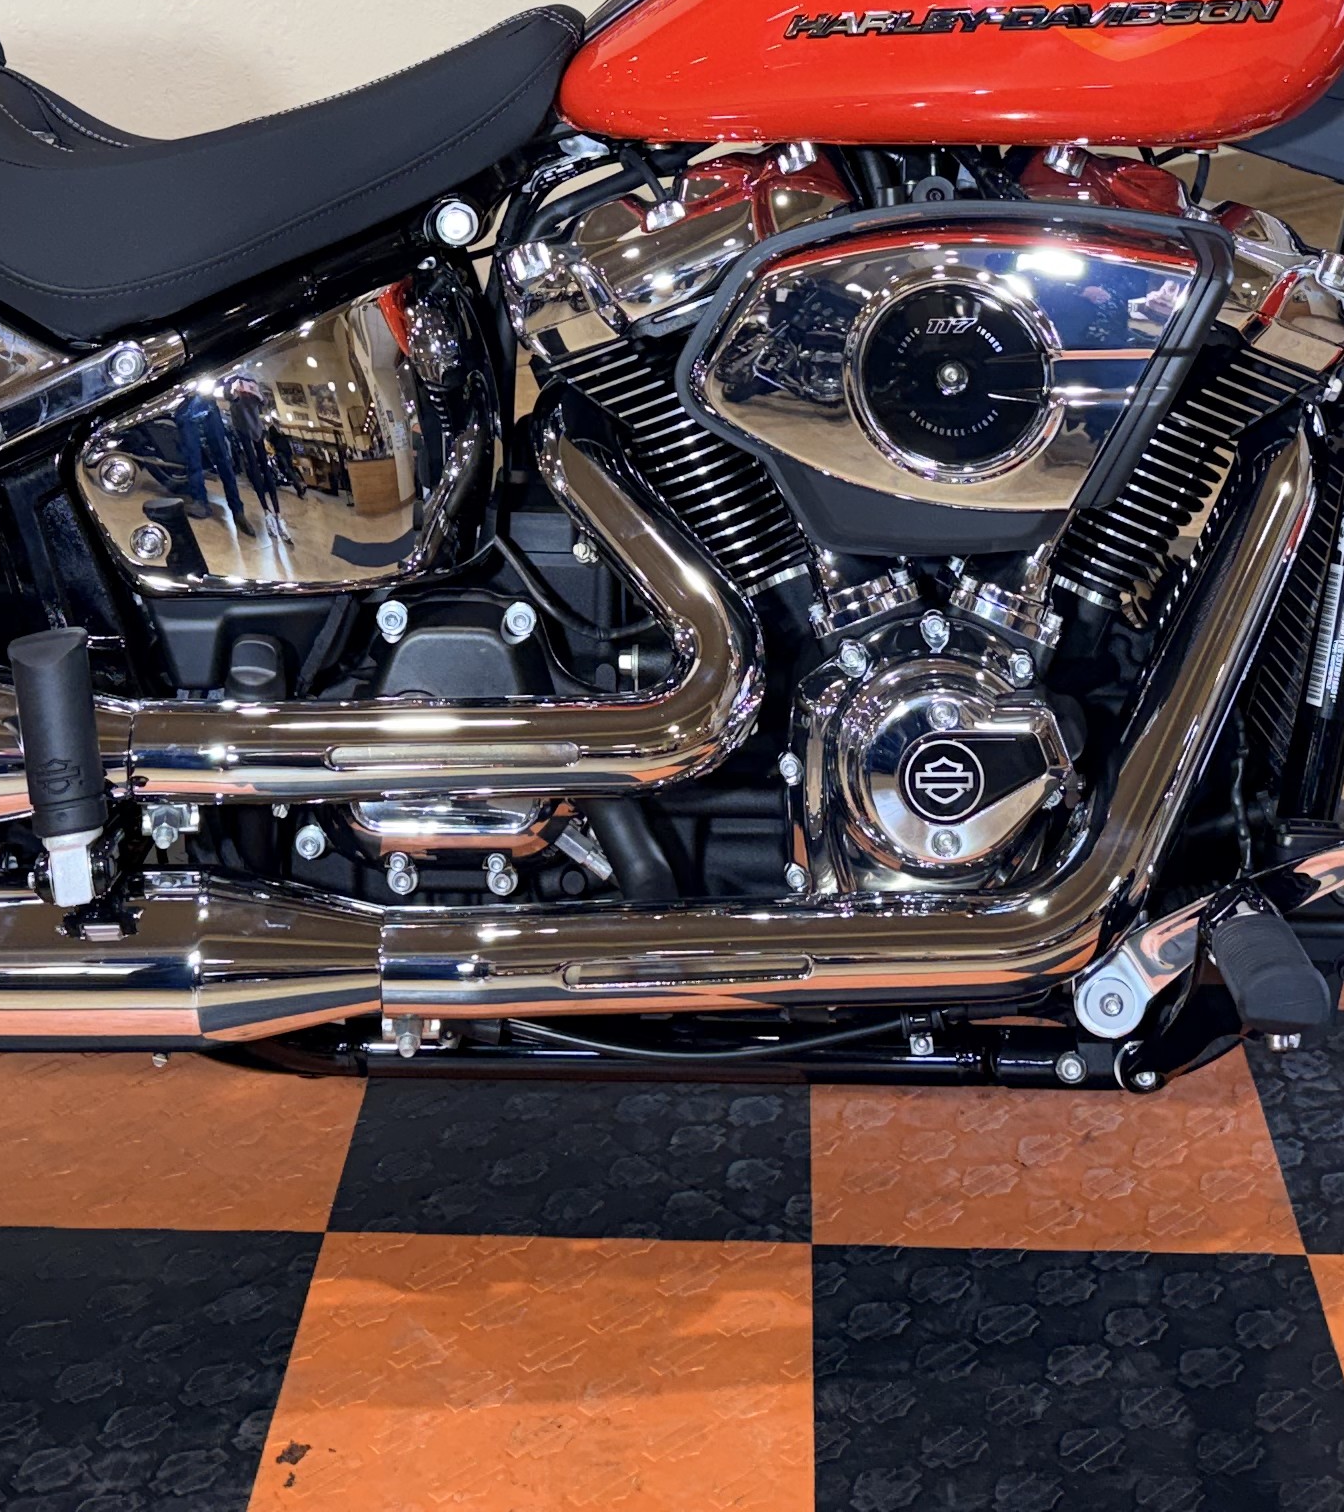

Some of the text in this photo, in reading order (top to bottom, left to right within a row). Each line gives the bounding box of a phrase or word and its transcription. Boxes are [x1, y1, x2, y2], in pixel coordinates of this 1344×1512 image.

[897, 317, 1002, 353] CUBIC 117 INCHES
